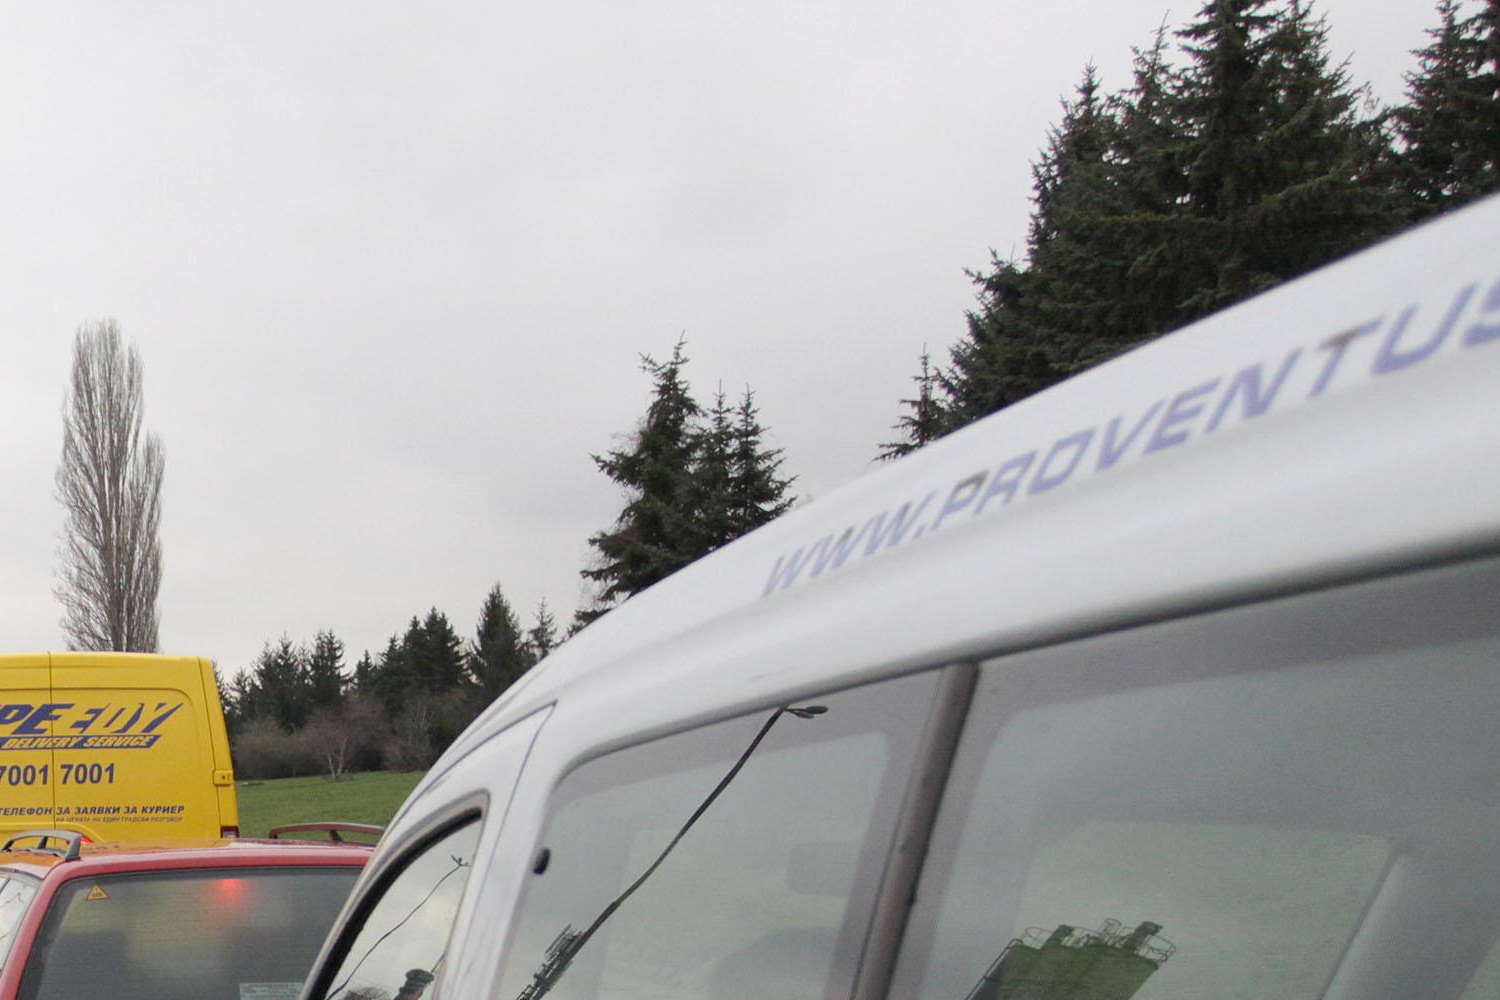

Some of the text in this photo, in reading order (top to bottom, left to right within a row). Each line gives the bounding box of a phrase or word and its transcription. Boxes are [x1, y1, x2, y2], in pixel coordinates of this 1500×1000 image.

[1, 736, 81, 750] DELIVERY
[81, 735, 153, 749] SERVICE
[60, 763, 115, 784] 7001
[56, 806, 71, 815] ЗА
[75, 805, 121, 815] ЗАЯВКИ
[124, 805, 138, 815] ЗА
[141, 804, 185, 814] КУРИЕР
